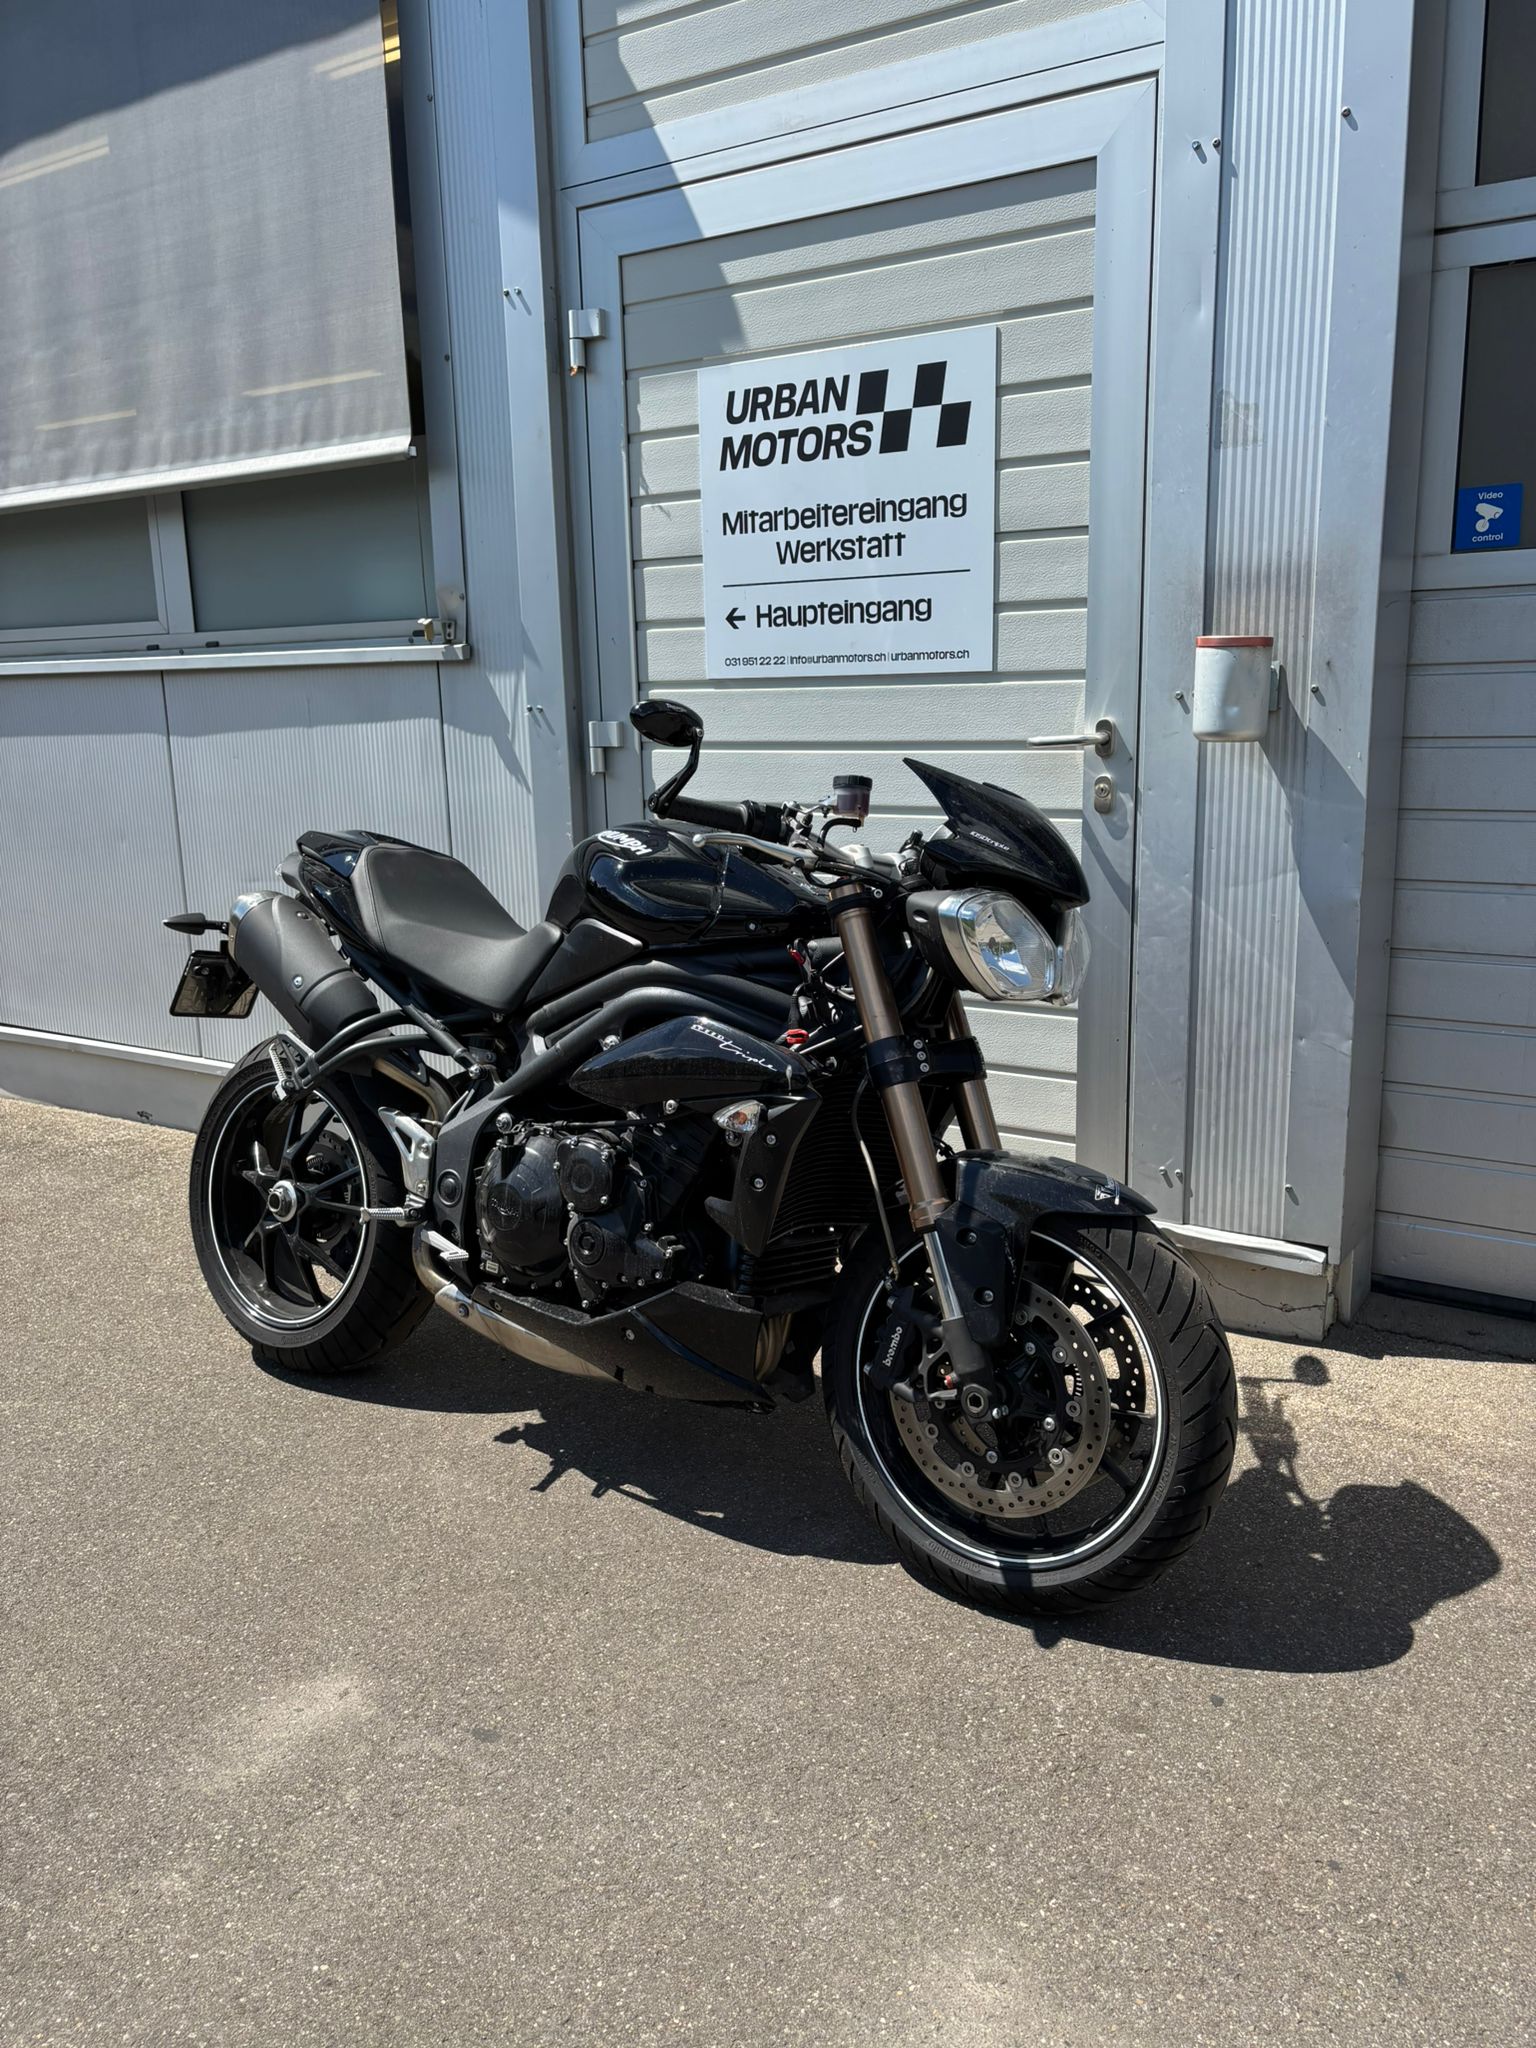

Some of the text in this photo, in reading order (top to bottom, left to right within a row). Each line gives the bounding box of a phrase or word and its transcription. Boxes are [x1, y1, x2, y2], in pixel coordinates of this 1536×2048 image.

[726, 374, 851, 425] URBAN
[719, 419, 874, 472] MOTORS
[1478, 491, 1504, 500] Video
[722, 493, 967, 536] Mitarbeitereingang
[776, 532, 906, 565] Werkstatt
[1472, 532, 1504, 543] control
[756, 598, 932, 628] Haupteingang
[724, 657, 741, 667] 031
[742, 656, 758, 666] 951
[759, 656, 772, 666] 22
[773, 655, 786, 665] 22
[890, 649, 970, 662] urbanmotors.ch
[882, 1326, 903, 1367] brembo
